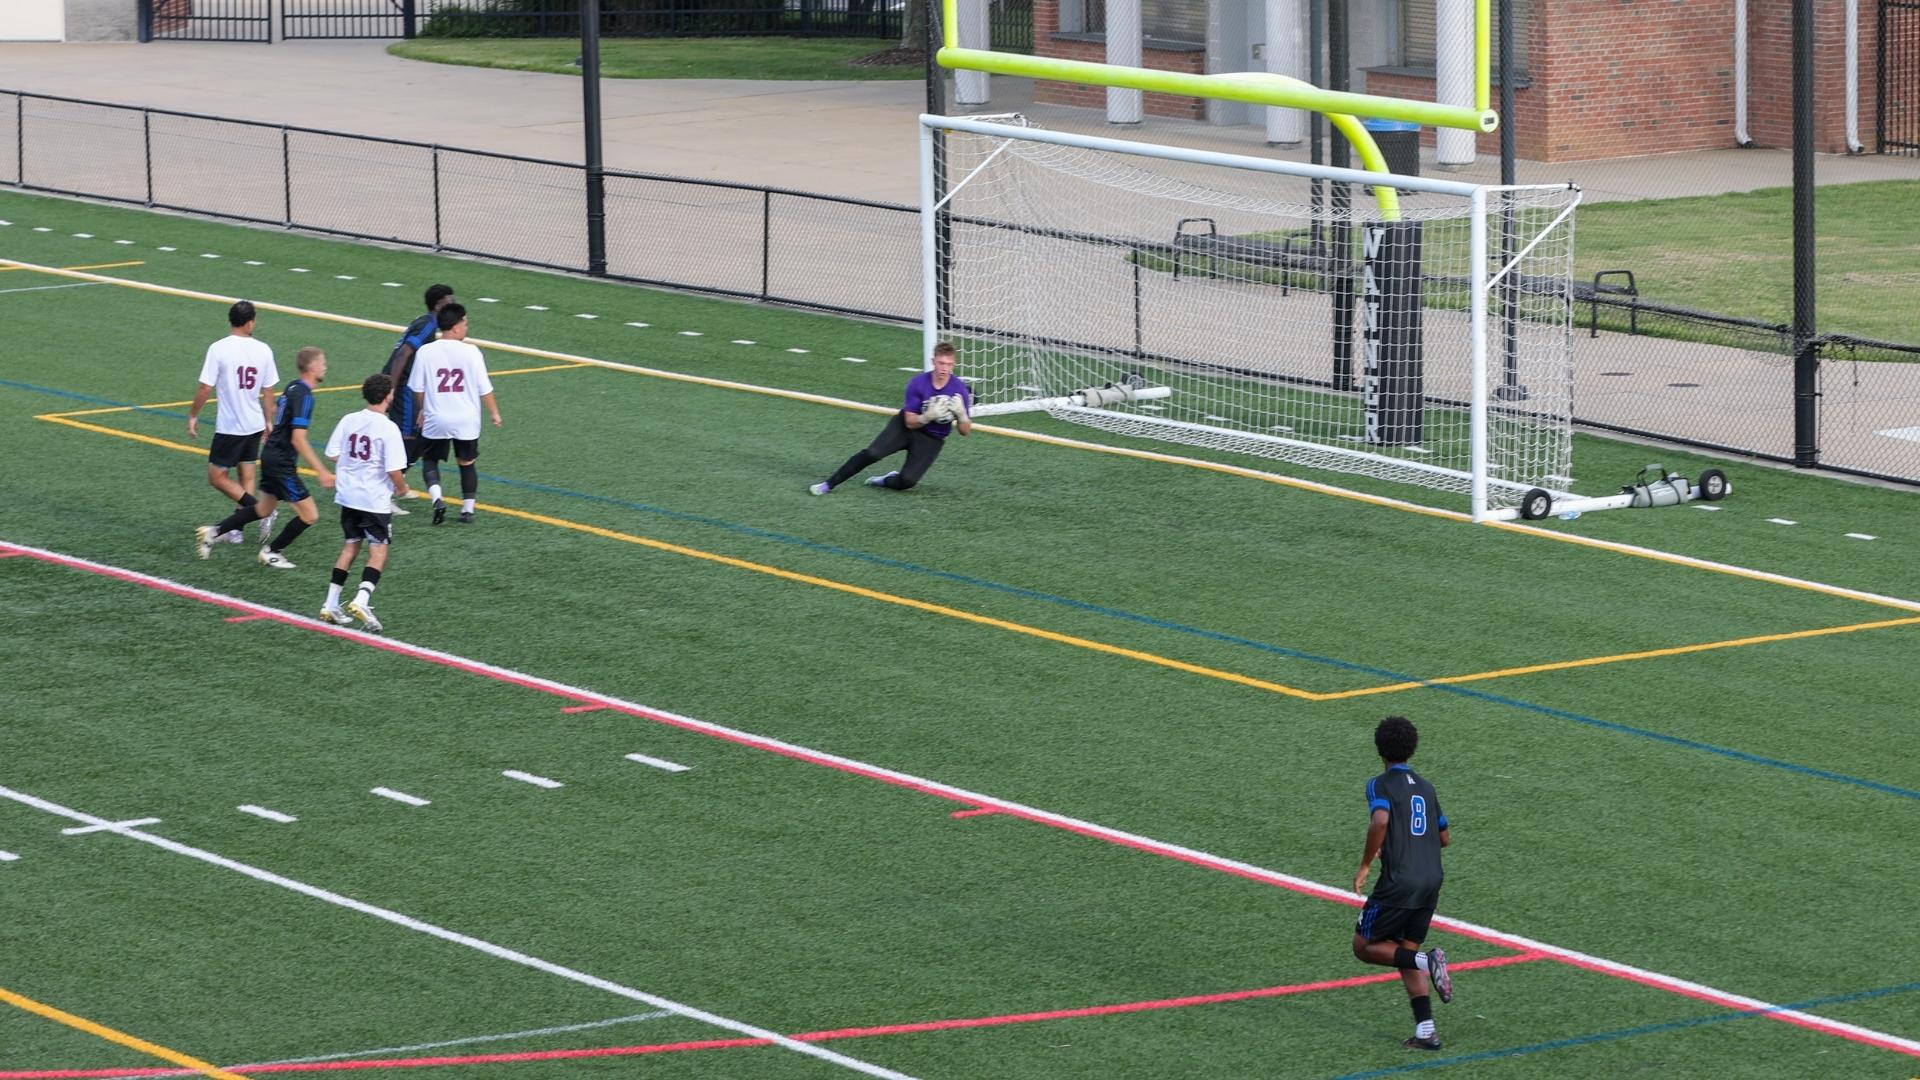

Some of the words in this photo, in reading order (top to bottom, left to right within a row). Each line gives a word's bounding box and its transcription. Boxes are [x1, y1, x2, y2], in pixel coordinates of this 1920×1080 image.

[237, 366, 257, 389] 16
[437, 368, 464, 392] 22
[349, 433, 371, 460] 13
[1411, 795, 1426, 835] 8
